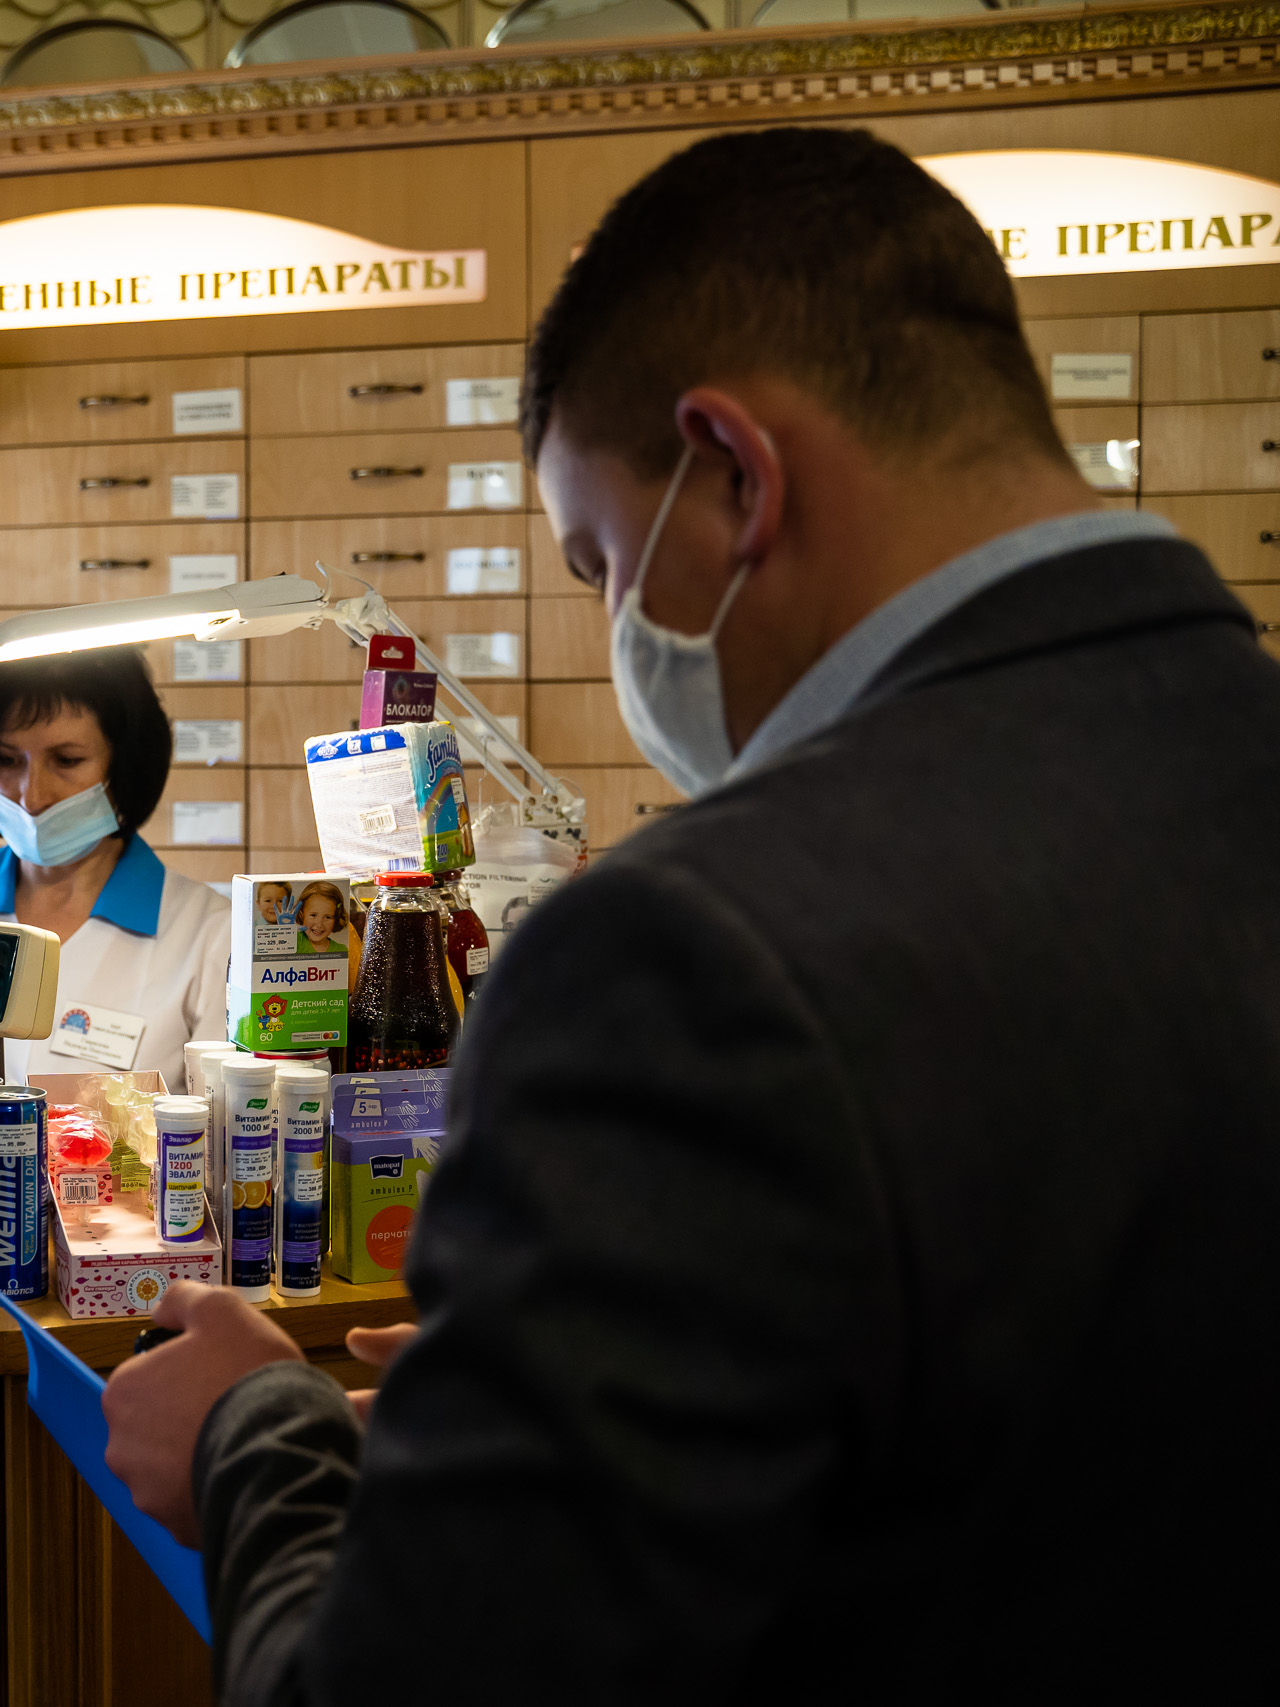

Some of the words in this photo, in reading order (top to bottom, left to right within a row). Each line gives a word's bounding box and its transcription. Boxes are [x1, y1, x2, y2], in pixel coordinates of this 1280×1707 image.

[1057, 213, 1280, 256] ПРЕПАР
[179, 256, 467, 302] ПРЕПАРАТЫ
[386, 703, 432, 717] БЛОКАТОР
[261, 966, 337, 987] АлфаВит
[291, 999, 328, 1010] Детский
[329, 999, 345, 1009] сад
[302, 1008, 319, 1016] детей
[259, 1032, 273, 1043] 60
[358, 1101, 366, 1114] 5
[235, 1114, 270, 1123] Витамин
[287, 1118, 320, 1126] Витамин
[351, 1120, 382, 1128] ambulex
[383, 1119, 388, 1127] P
[241, 1124, 262, 1132] 1000
[293, 1127, 313, 1135] 2000
[168, 1135, 192, 1144] Эвалар
[25, 1155, 35, 1177] DRI
[169, 1162, 192, 1170] 1200
[373, 1162, 400, 1171] matopat
[169, 1170, 201, 1179] ЭВАЛАР
[370, 1185, 406, 1195] ambulex
[408, 1184, 413, 1193] P
[25, 1182, 35, 1233] VITAMIN
[371, 1230, 413, 1240] перчатк
[0, 1287, 34, 1296] ABIOTICS
[128, 1270, 150, 1303] ПРАВИЛЬНЫЕ
